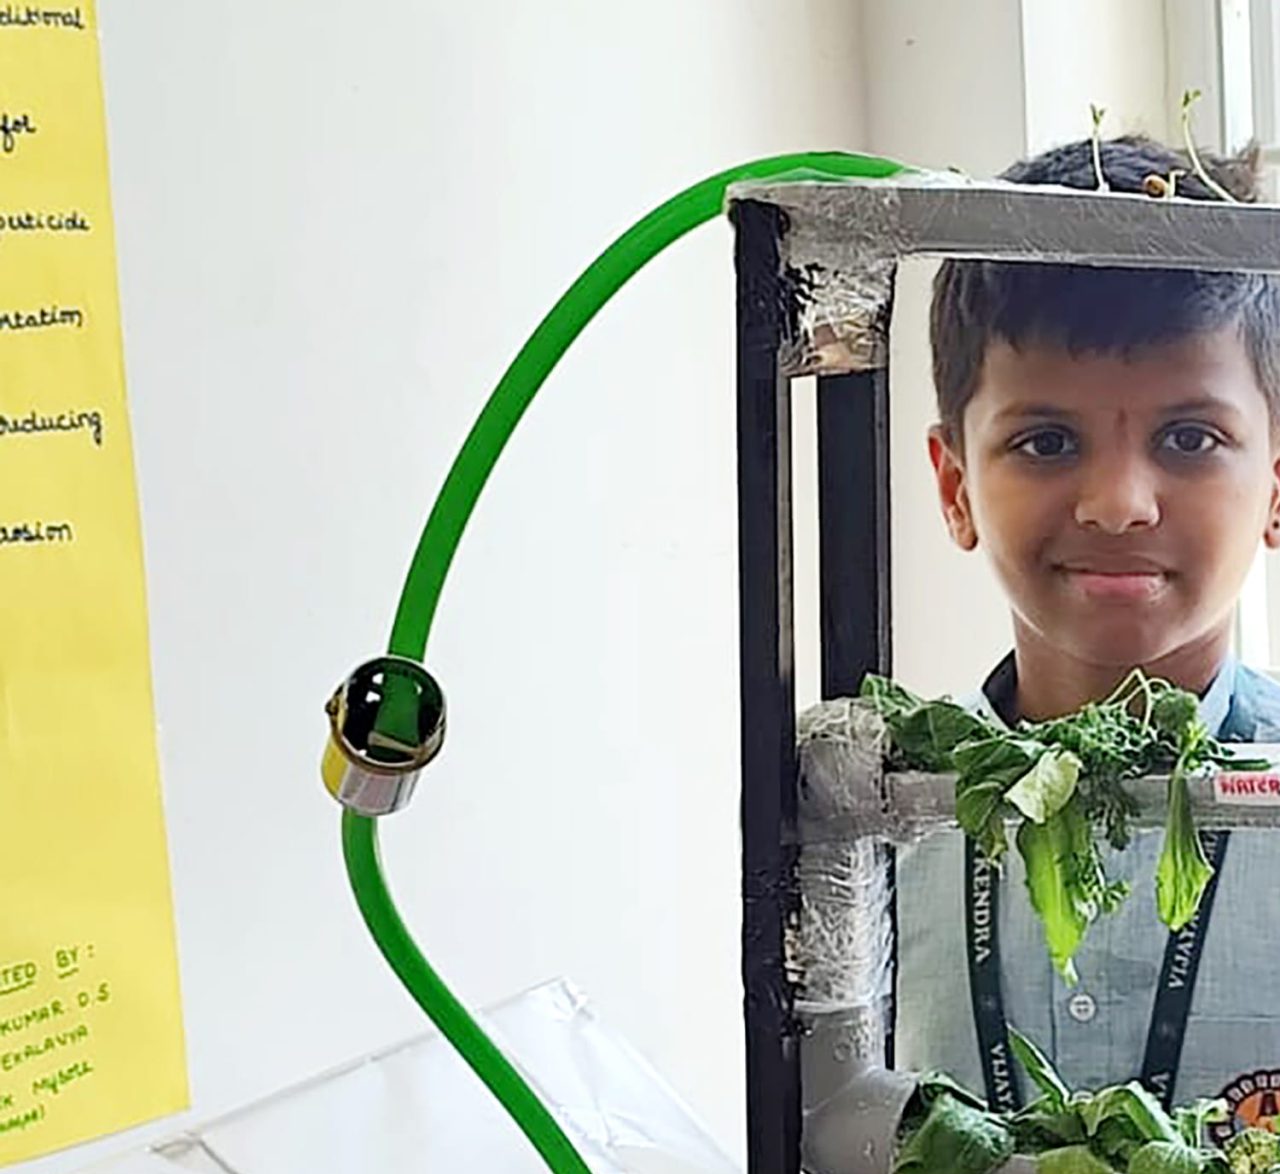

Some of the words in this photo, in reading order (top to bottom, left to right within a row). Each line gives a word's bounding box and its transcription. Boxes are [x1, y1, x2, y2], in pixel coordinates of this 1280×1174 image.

[0, 5, 85, 30] ditional
[972, 857, 992, 963] KENDRA
[0, 962, 37, 985] TED
